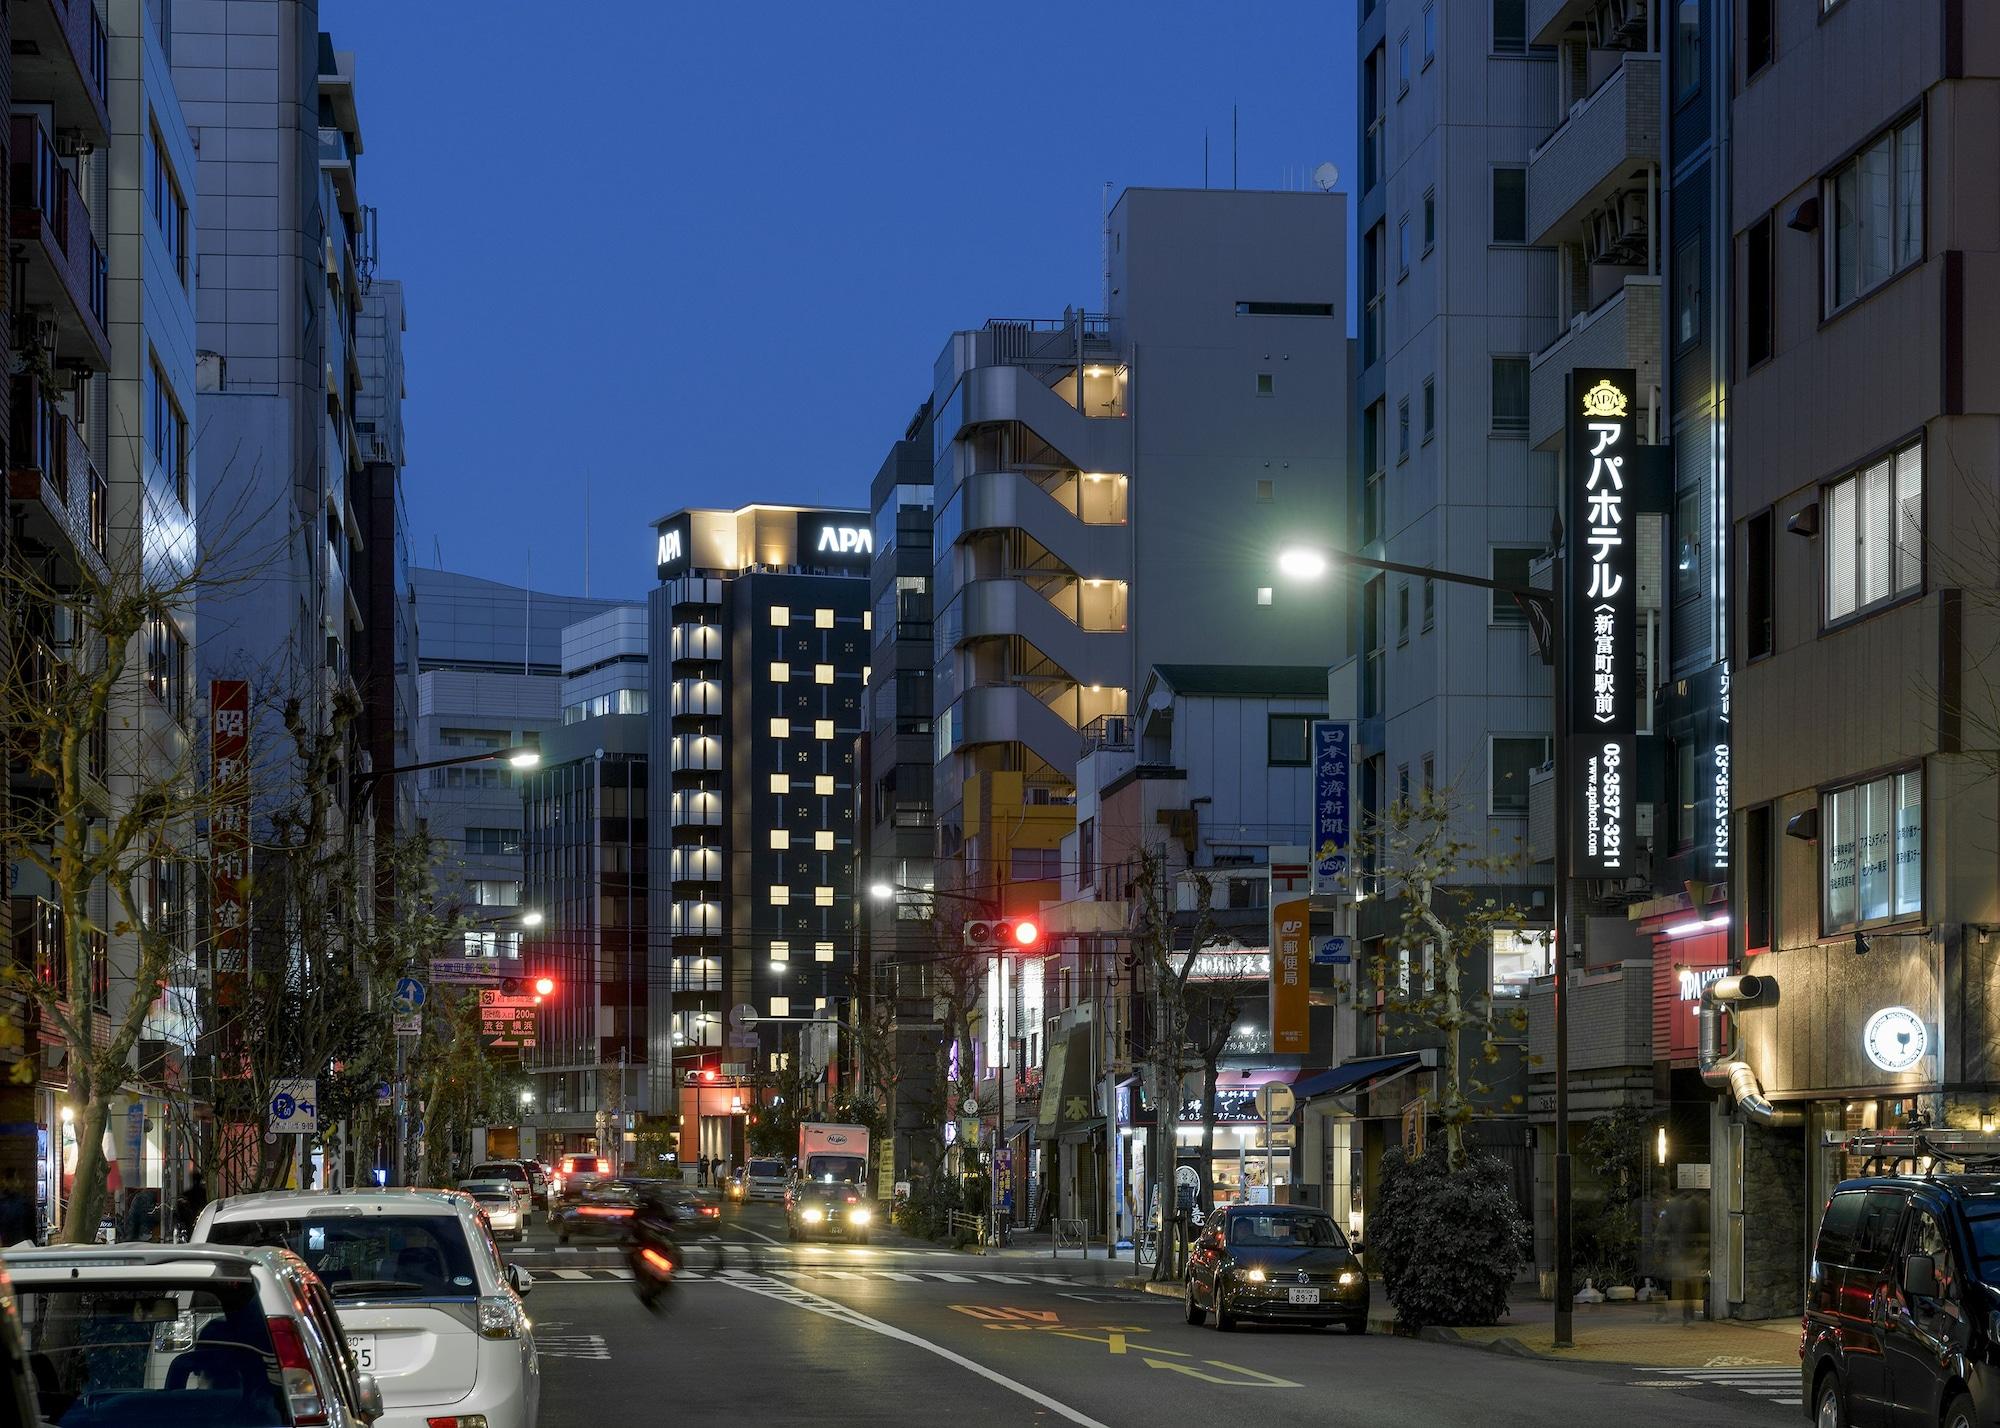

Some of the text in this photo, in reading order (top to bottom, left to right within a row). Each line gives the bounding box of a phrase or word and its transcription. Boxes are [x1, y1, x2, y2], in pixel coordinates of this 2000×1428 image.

[1586, 423, 1623, 598] アパホテル
[657, 530, 681, 565] APA
[818, 526, 872, 553] APA
[1586, 756, 1600, 856] www.apahotel.com
[1603, 743, 1620, 868] 03-3537-3211
[1283, 940, 1298, 986] 郵便局
[484, 1021, 533, 1030] 渋谷 横浜
[515, 1009, 535, 1019] 200m
